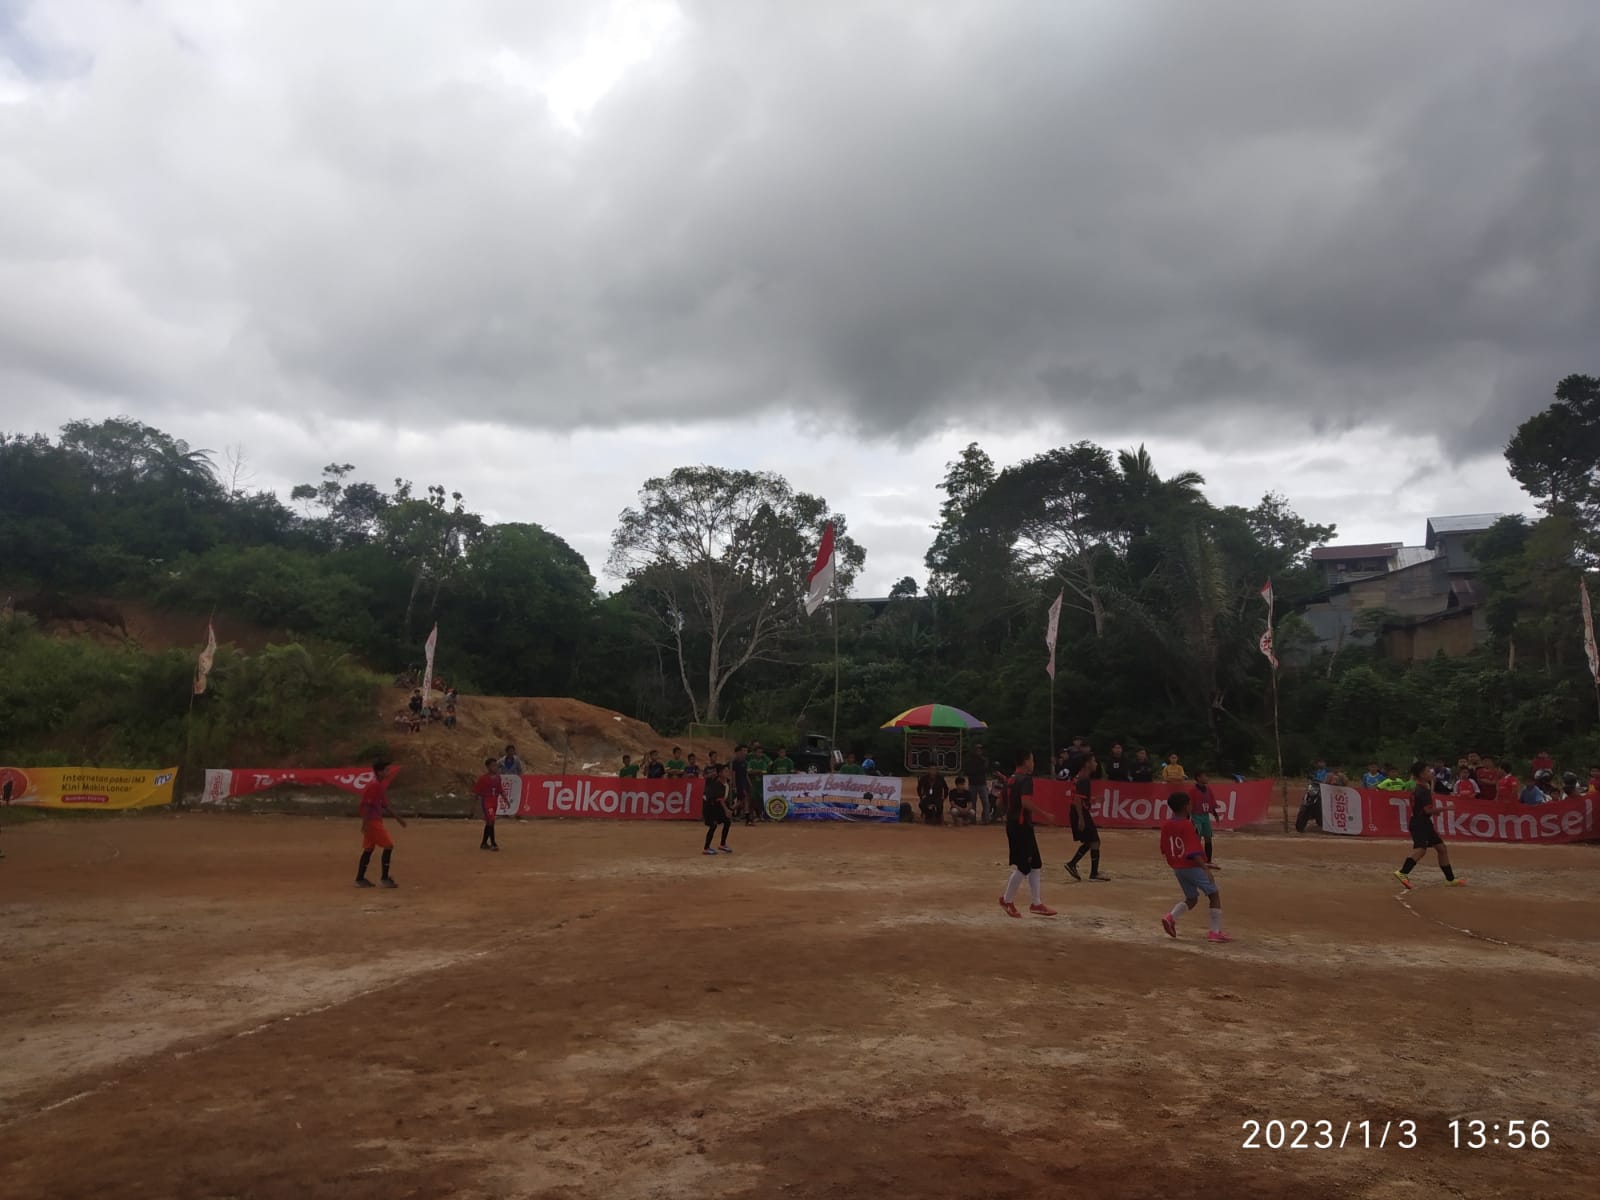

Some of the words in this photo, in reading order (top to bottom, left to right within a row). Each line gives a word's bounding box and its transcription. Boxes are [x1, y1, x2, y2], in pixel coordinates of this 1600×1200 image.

[542, 780, 692, 814] Telkomsel
[768, 774, 822, 792] Selamat
[1388, 797, 1593, 840] Tlkomsel
[1169, 835, 1185, 857] 19
